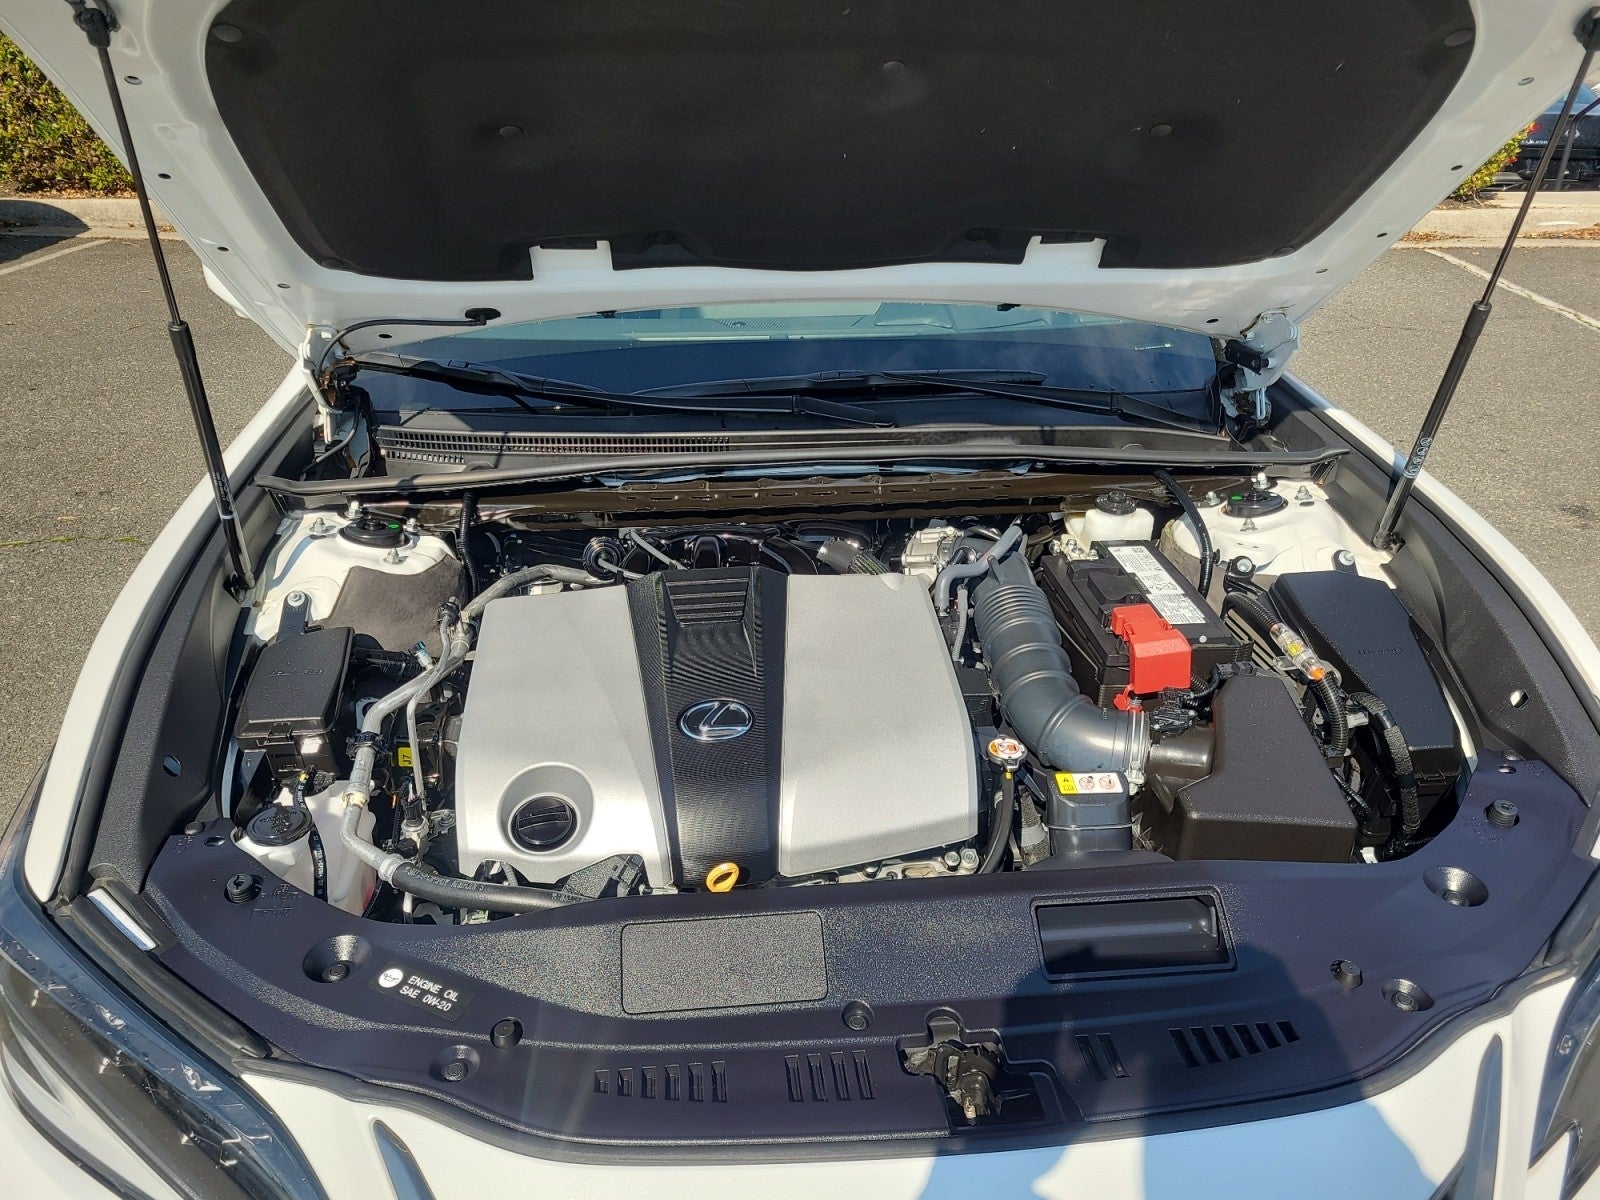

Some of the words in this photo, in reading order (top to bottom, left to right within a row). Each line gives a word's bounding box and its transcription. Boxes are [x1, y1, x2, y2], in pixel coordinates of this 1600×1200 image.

[399, 985, 421, 999] SAE
[422, 994, 452, 1012] 0W-20
[407, 975, 442, 994] ENGINE
[443, 989, 459, 1002] OIL
